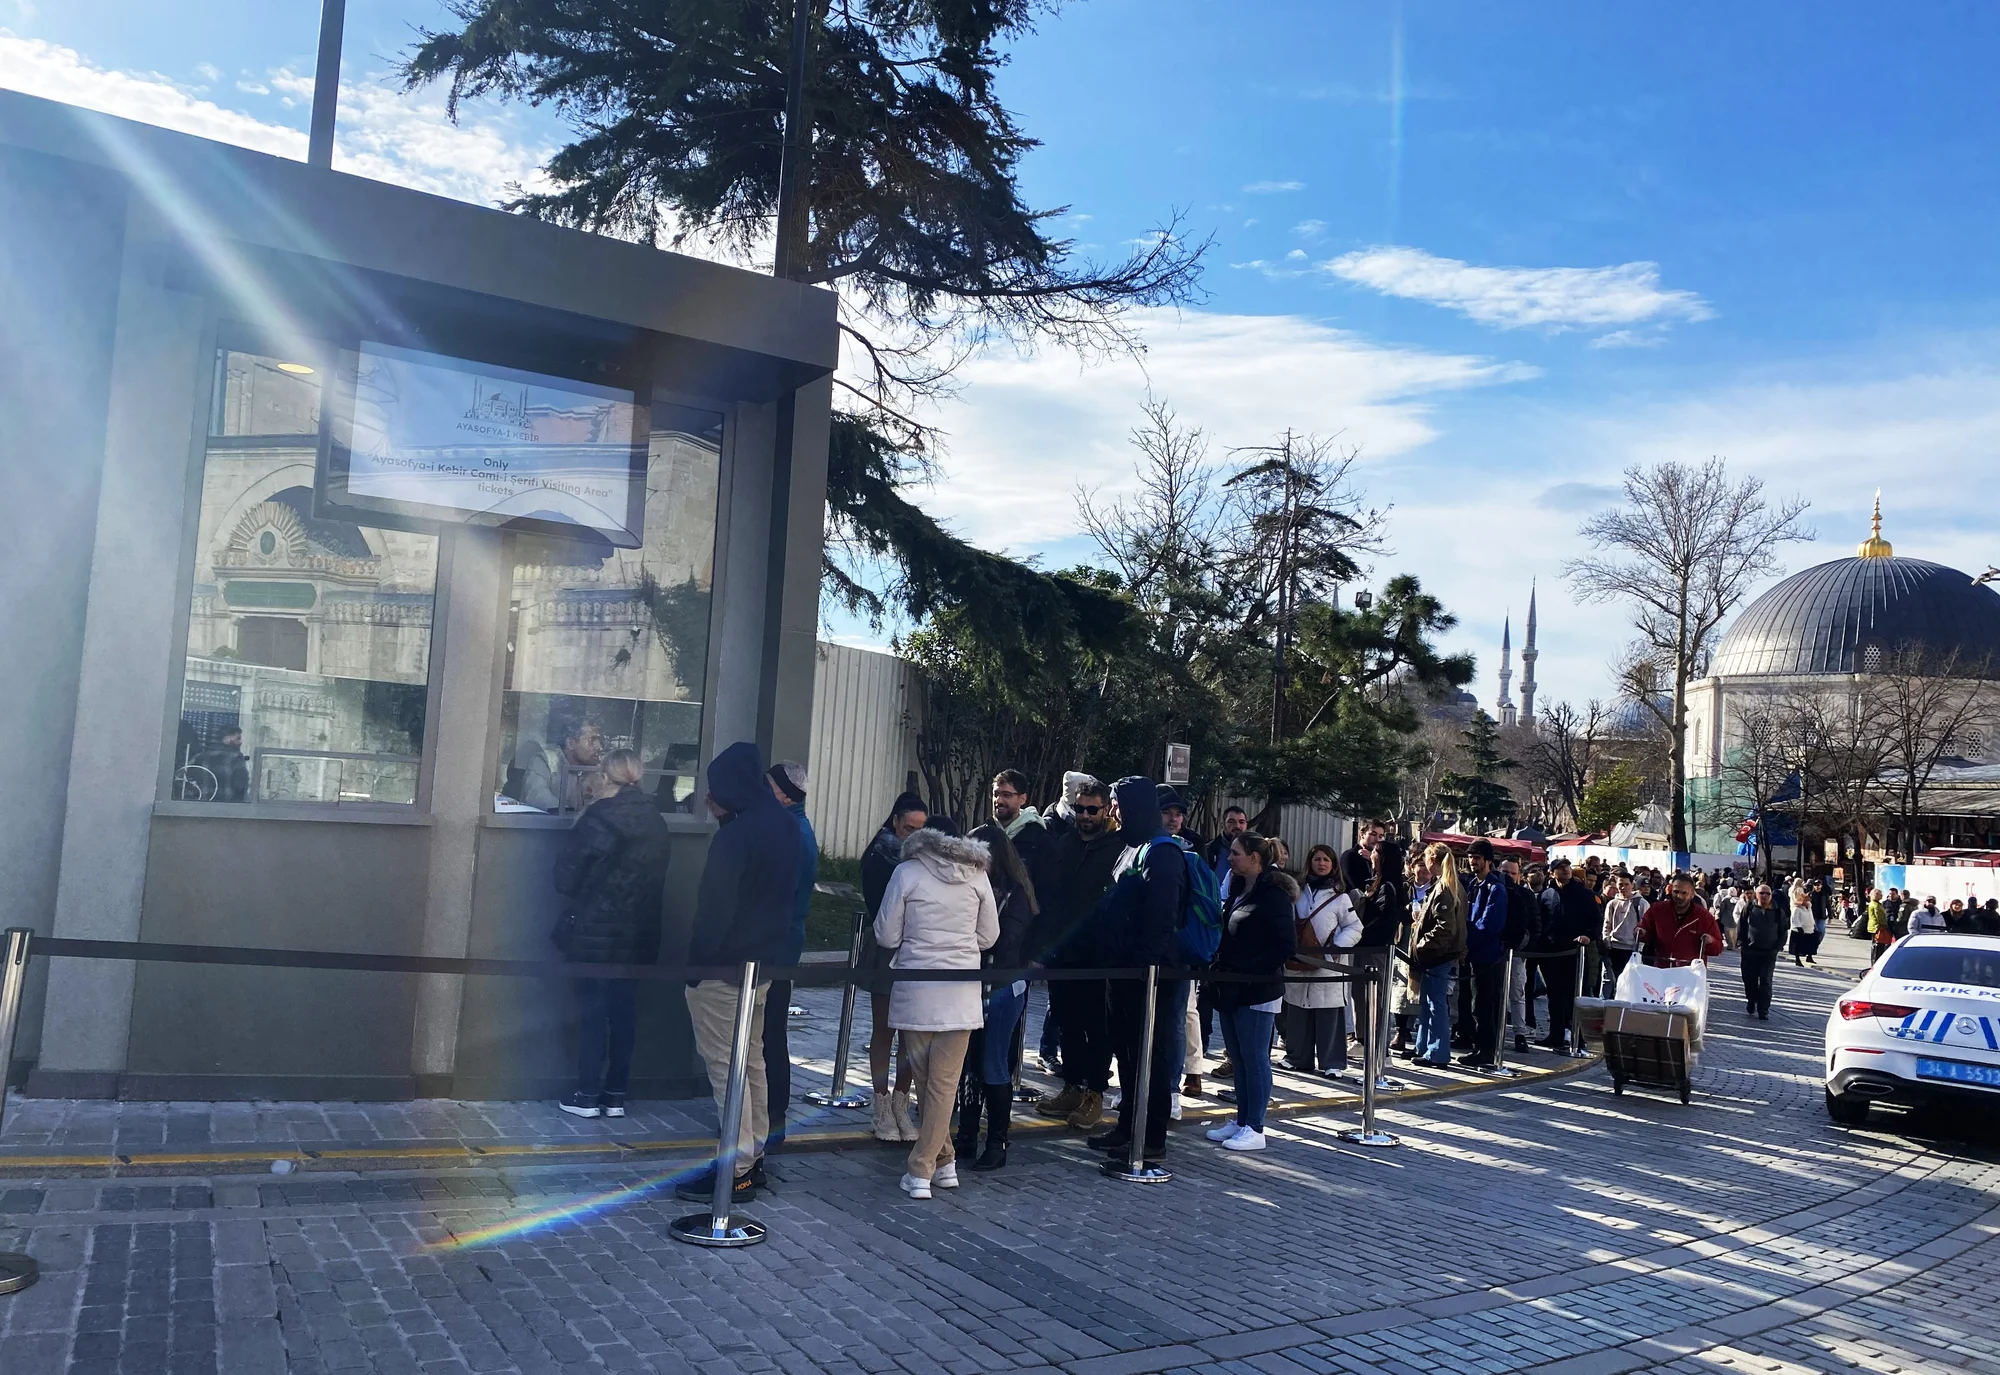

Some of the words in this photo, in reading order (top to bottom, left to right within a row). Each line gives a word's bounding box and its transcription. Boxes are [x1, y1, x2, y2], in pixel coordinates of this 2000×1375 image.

[456, 422, 511, 438] AYASOFYA-İ
[513, 431, 540, 442] KEBİR
[483, 457, 509, 471] Only
[438, 463, 468, 476] Kebir
[470, 468, 508, 482] Cami-i
[510, 474, 539, 487] Şerifi
[542, 479, 581, 496] Visiting
[477, 482, 515, 496] tickets
